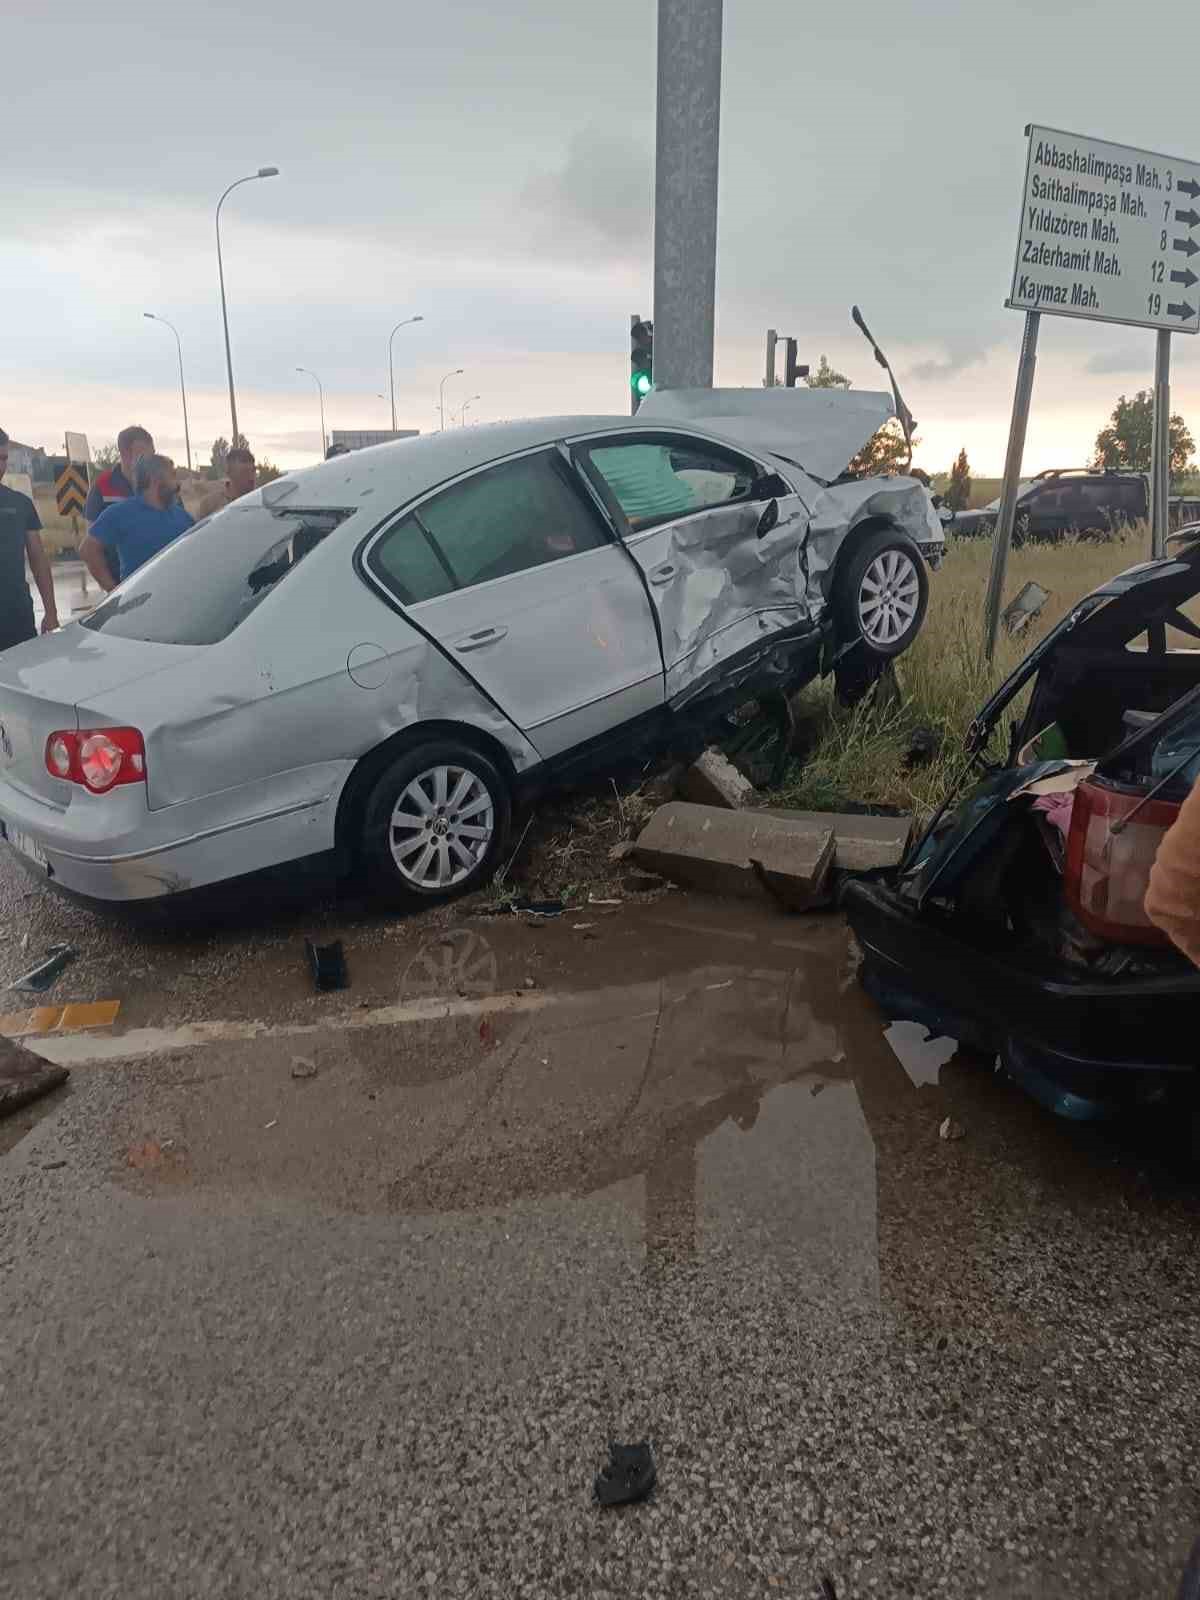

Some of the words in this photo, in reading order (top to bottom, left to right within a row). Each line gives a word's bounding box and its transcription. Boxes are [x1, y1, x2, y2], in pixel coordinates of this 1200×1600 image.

[1035, 141, 1132, 187] Abbashalimpaşa
[1135, 163, 1162, 190] Mah.
[1165, 170, 1173, 192] 3
[1031, 174, 1117, 216] Saithalimpaşa
[1120, 191, 1147, 218] Mah.
[1163, 200, 1171, 222] 7
[1091, 217, 1119, 244] Mah.
[1160, 229, 1167, 251] 8
[1022, 239, 1090, 272] Zaferhamit
[1093, 249, 1121, 276] Mah.
[1151, 260, 1165, 284] 12
[1018, 275, 1067, 306] Kaymaz
[1070, 282, 1099, 309] Mah.
[1148, 293, 1161, 316] 19
